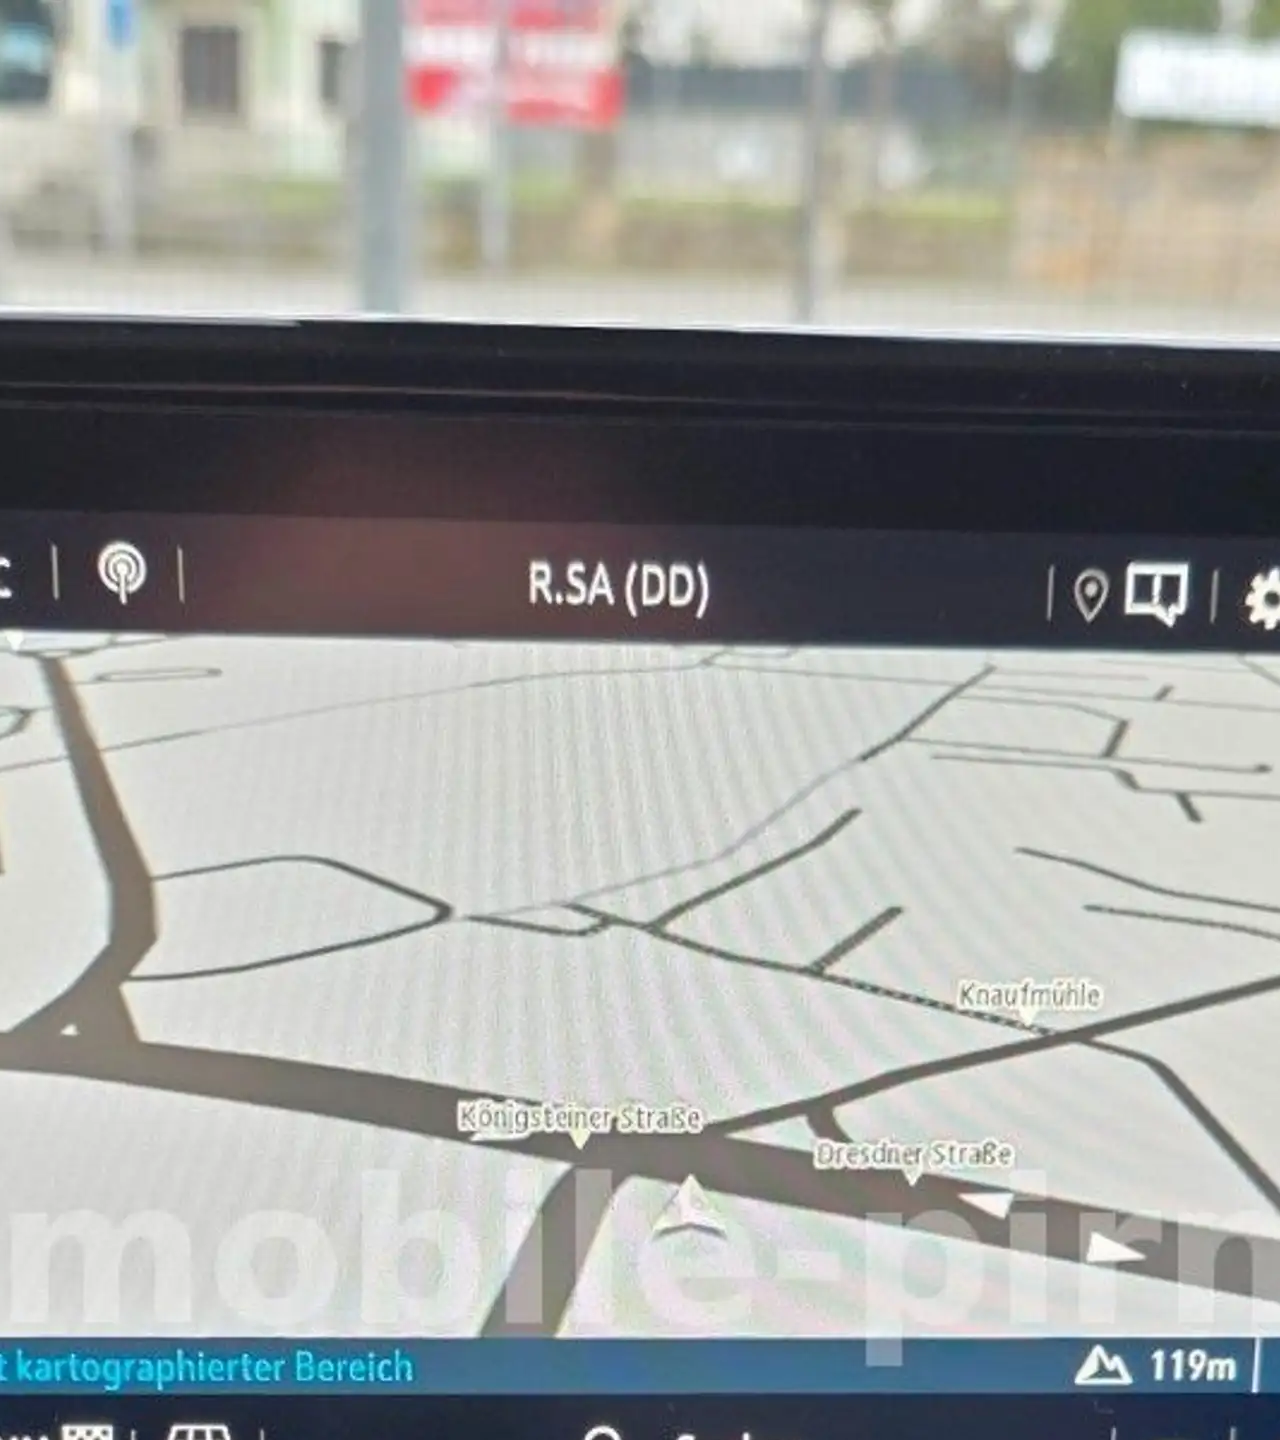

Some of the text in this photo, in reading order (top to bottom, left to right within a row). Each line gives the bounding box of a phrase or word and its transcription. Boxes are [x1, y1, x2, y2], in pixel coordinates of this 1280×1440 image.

[528, 558, 711, 618] R.SA (DD)
[958, 980, 1102, 1010] Knaufmühle
[458, 1102, 702, 1135] Königsteiner Straße
[814, 1140, 1013, 1167] Dresdner Straße
[16, 1349, 285, 1391] kartographierter
[296, 1350, 414, 1384] Bereich
[1150, 1350, 1238, 1382] 119m
